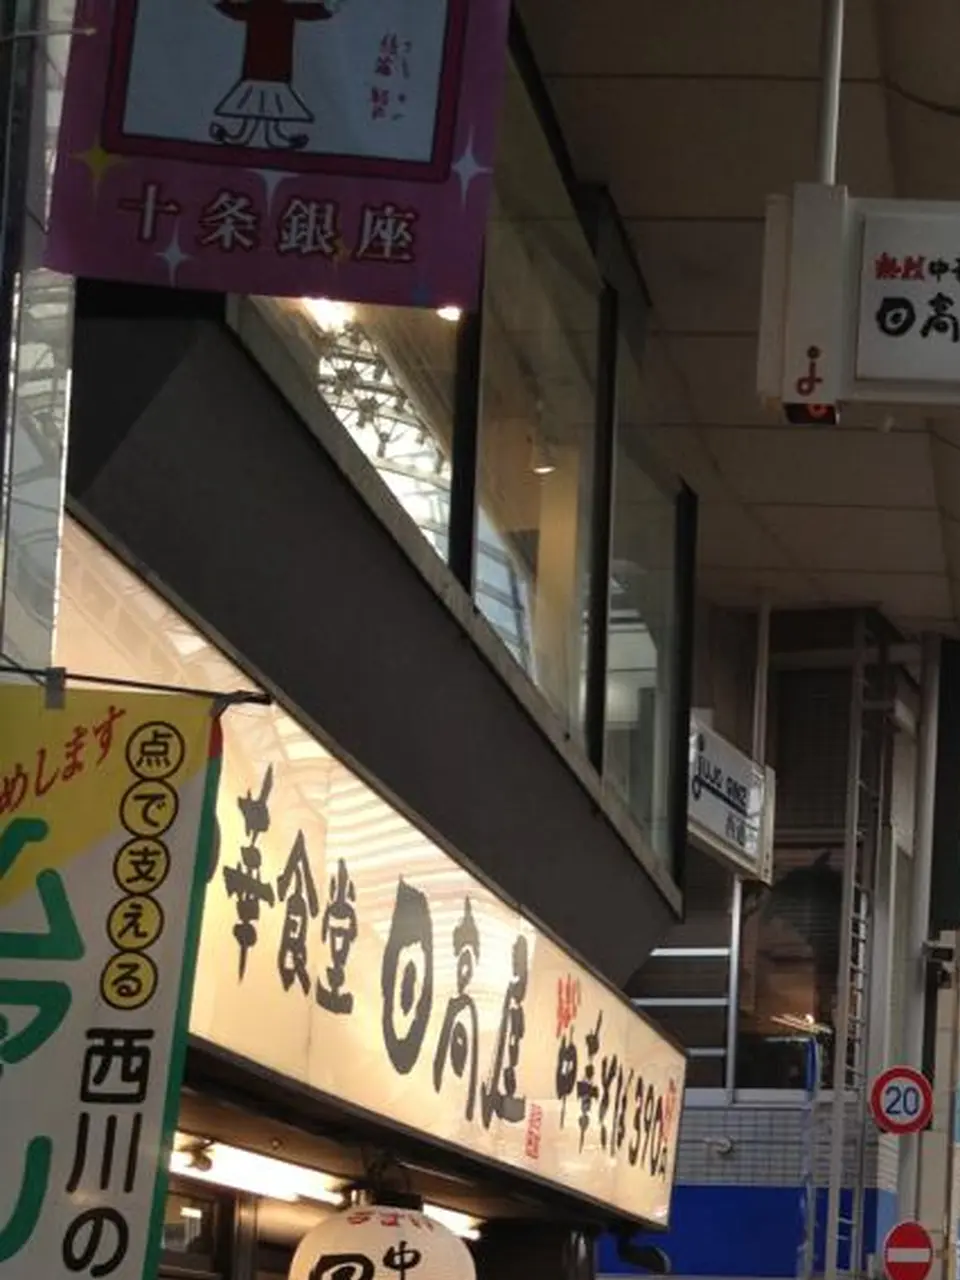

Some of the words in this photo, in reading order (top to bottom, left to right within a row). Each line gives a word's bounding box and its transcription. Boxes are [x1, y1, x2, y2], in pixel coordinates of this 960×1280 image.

[118, 182, 417, 262] 十条銀座
[100, 720, 186, 1010] 点で支える
[207, 763, 358, 1015] 華食堂
[381, 873, 528, 1130] 日高屋
[885, 1085, 919, 1116] 20
[62, 1027, 154, 1279] 西川の
